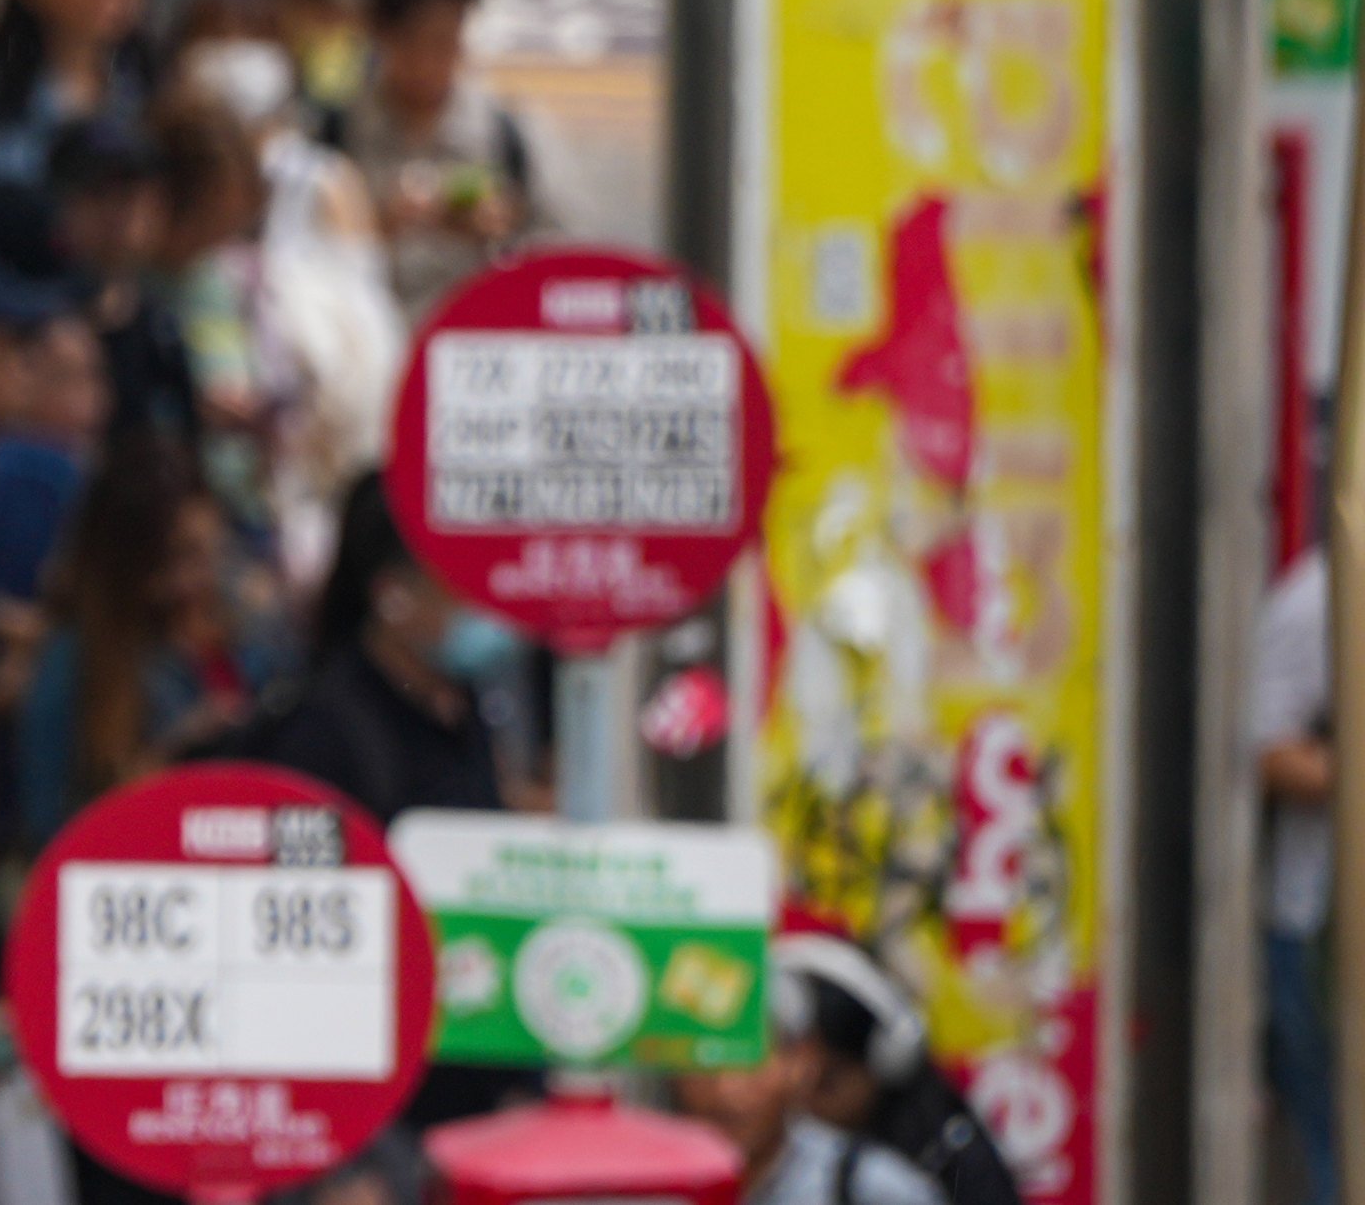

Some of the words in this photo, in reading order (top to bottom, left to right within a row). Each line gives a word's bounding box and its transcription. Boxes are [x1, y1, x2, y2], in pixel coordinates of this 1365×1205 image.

[89, 885, 194, 954] 98C
[253, 891, 356, 955] 98S
[75, 982, 209, 1051] 298X
